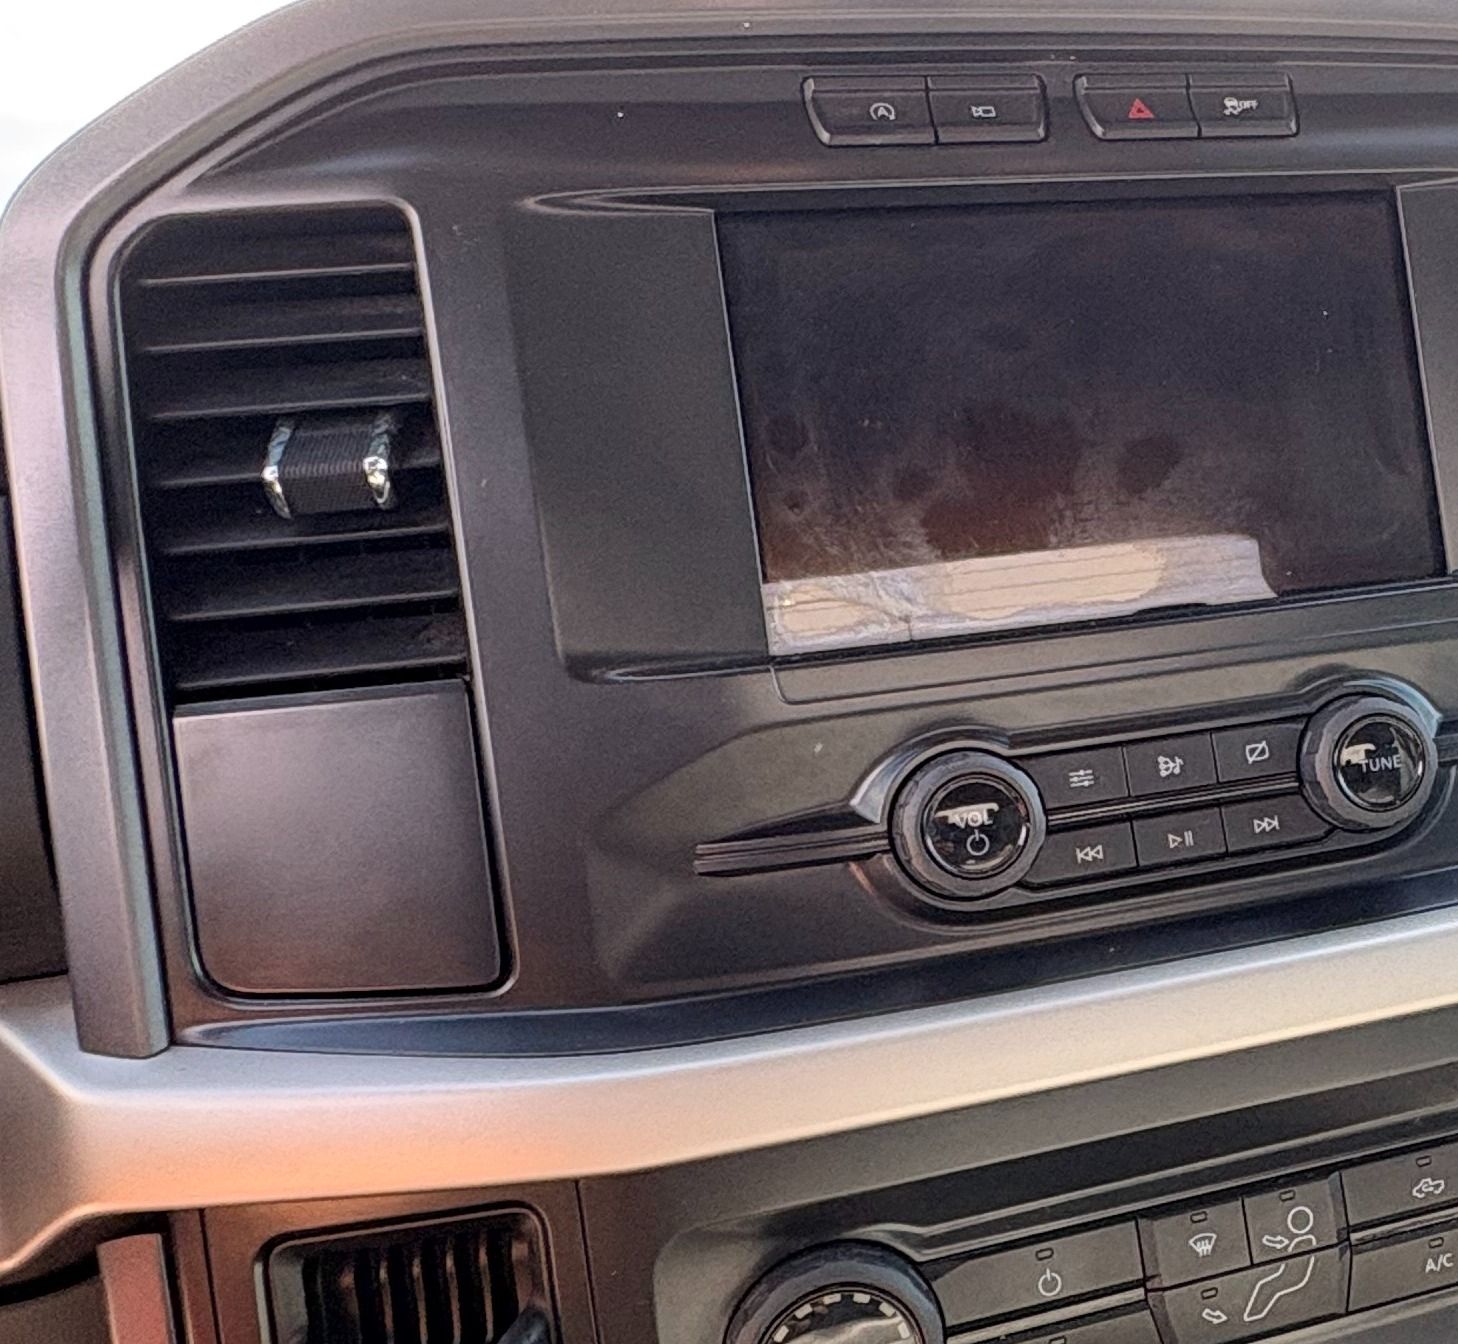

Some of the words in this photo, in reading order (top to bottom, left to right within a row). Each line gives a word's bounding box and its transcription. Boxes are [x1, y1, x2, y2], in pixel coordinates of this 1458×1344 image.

[1239, 99, 1258, 111] OFF
[1359, 754, 1402, 773] TUNE
[953, 808, 994, 829] VOL
[1425, 1253, 1454, 1273] A/C
